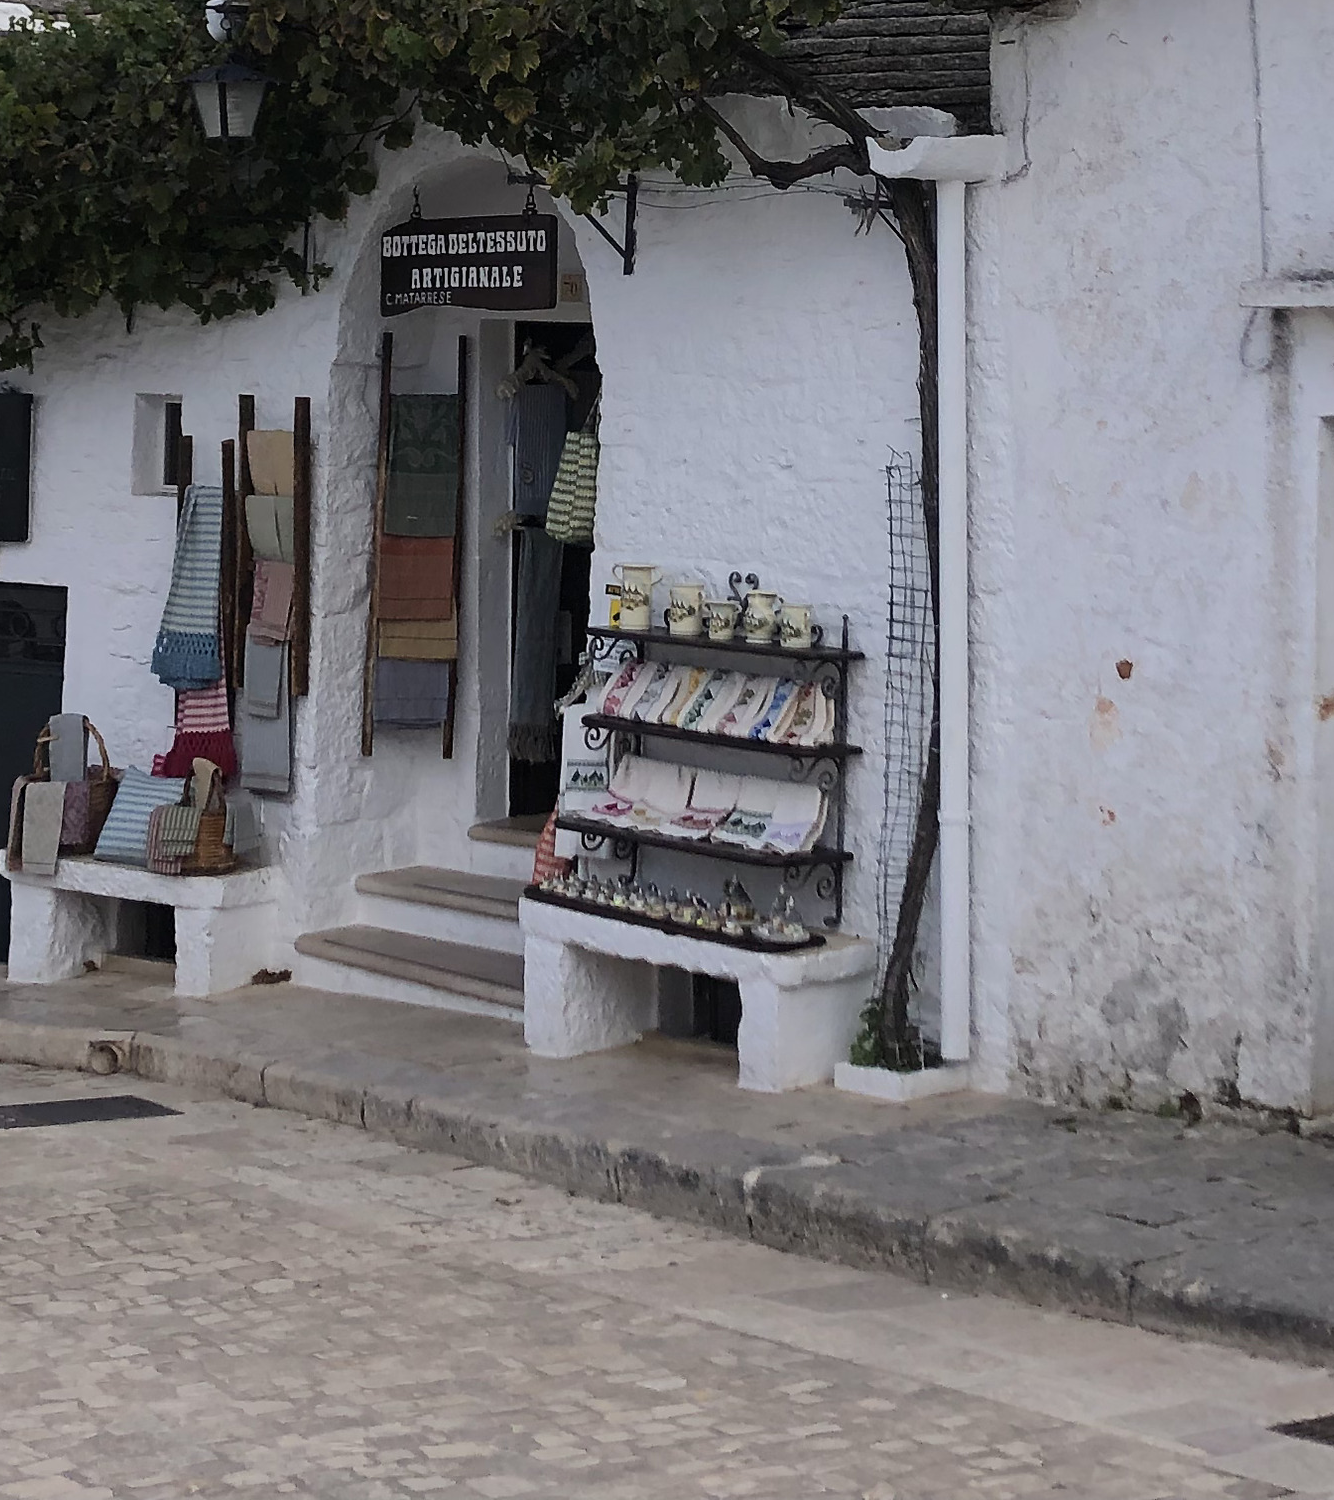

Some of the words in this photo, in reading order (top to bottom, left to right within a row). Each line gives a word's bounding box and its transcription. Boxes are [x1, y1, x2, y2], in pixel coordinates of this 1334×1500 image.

[382, 234, 446, 257] BOTTEGA
[448, 232, 477, 255] DEL
[476, 230, 547, 254] TESSUTO
[411, 266, 524, 290] ARTIGIANALE
[394, 290, 453, 305] MATARRESE
